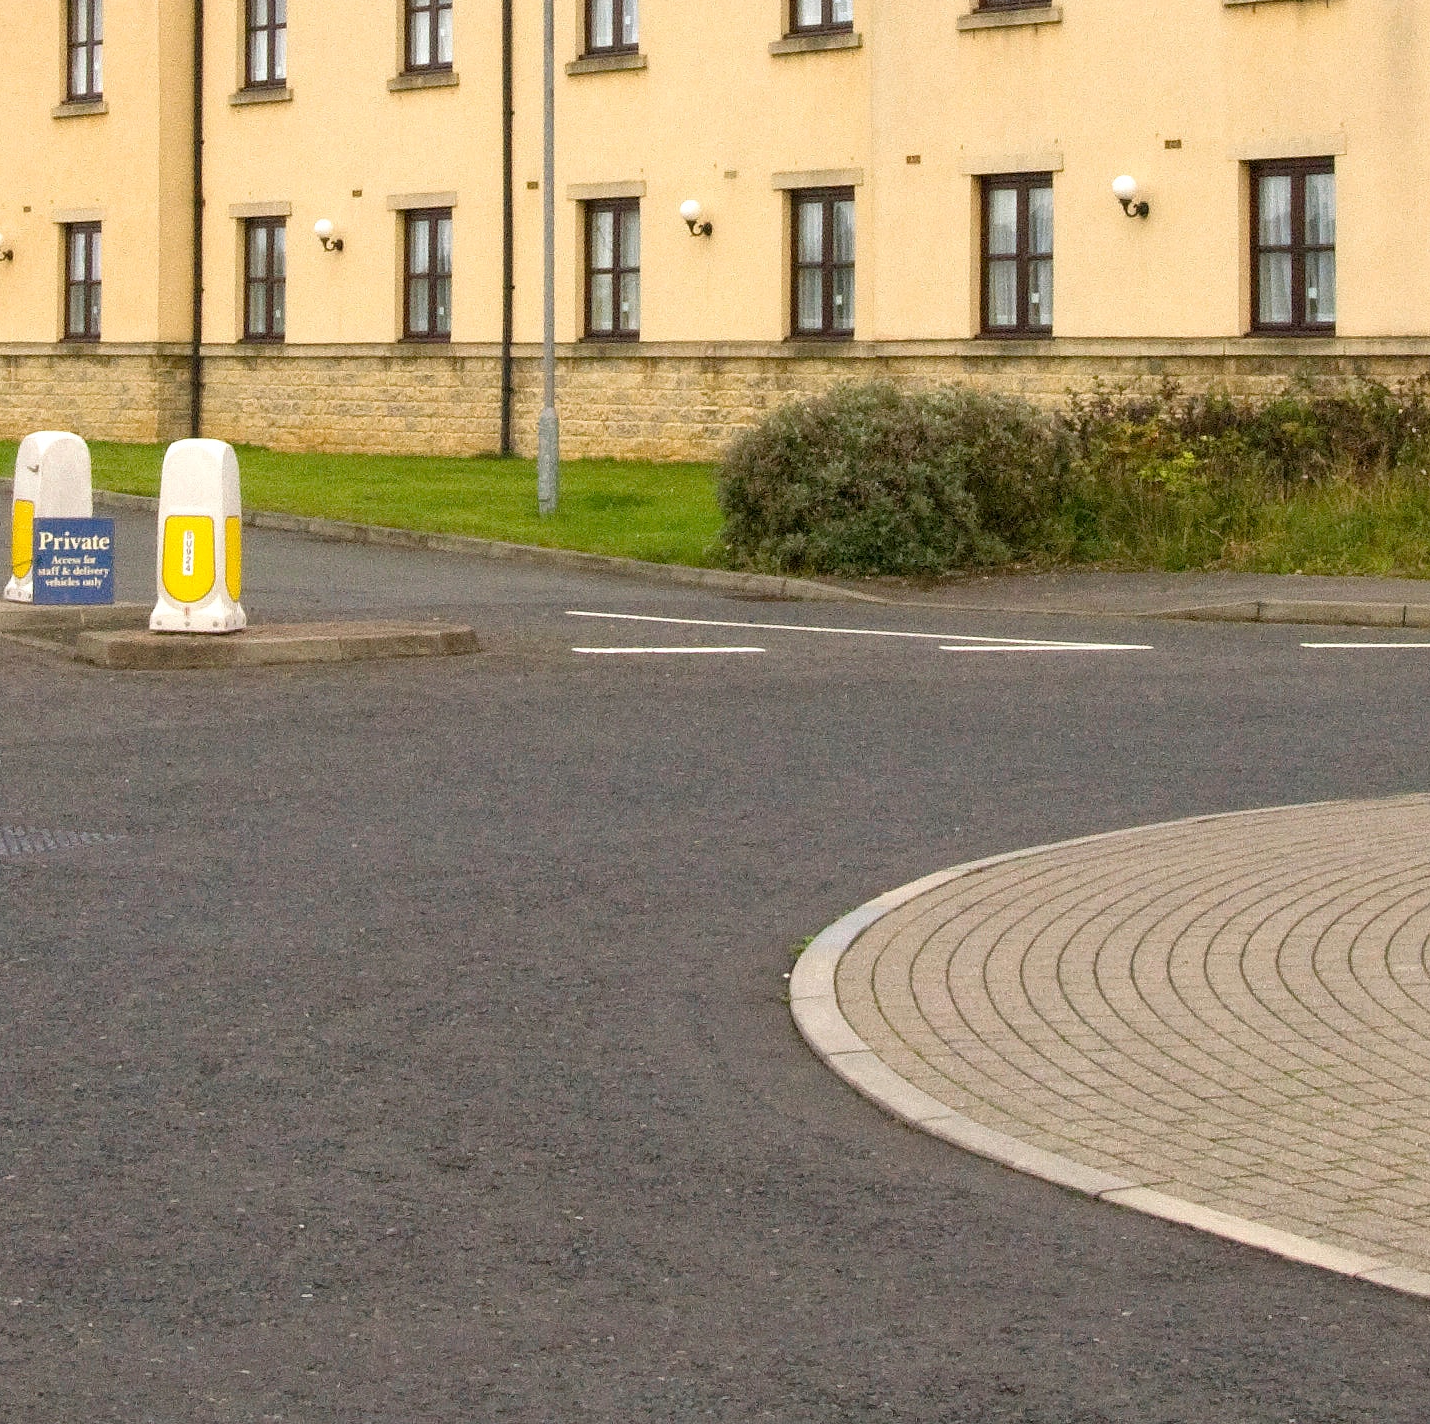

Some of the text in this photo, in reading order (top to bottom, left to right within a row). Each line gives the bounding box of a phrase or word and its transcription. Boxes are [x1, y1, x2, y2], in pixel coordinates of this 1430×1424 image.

[38, 531, 110, 551] Private
[52, 554, 96, 565] Access for
[38, 566, 59, 576] staff
[73, 565, 110, 578] delivery
[45, 577, 102, 590] vehicles only
